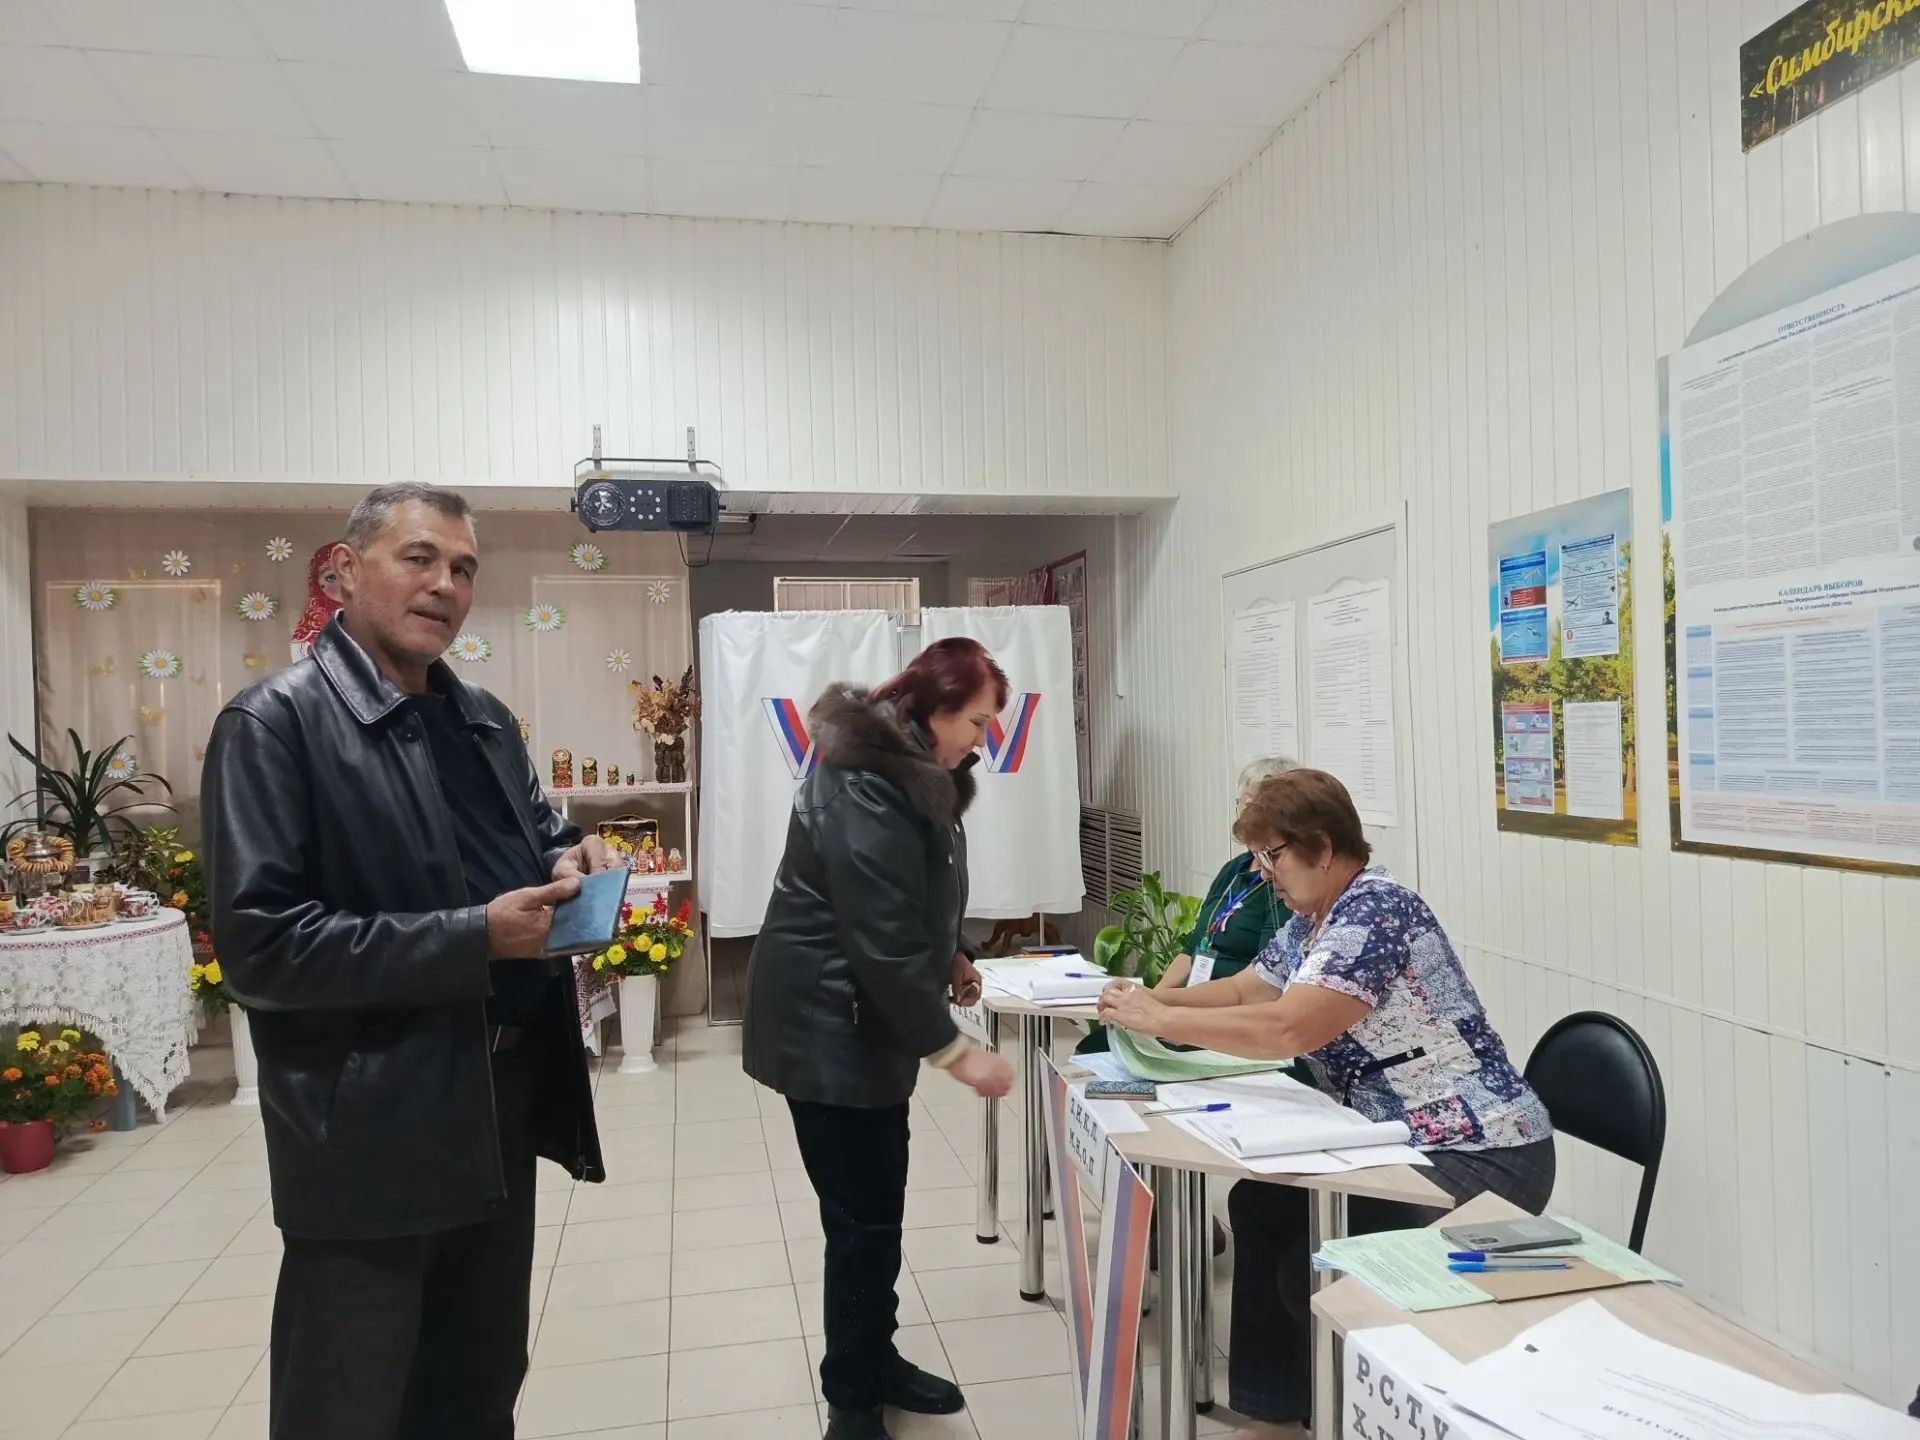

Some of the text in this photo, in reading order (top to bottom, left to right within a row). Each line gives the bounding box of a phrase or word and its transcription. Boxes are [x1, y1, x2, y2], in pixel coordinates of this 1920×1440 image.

[1777, 302, 1846, 333] ОТВЕТСТВЕННОСТЬ
[1778, 583, 1822, 598] КАЛЕНДАРЬ
[1823, 579, 1863, 591] ВЫБОРОВ
